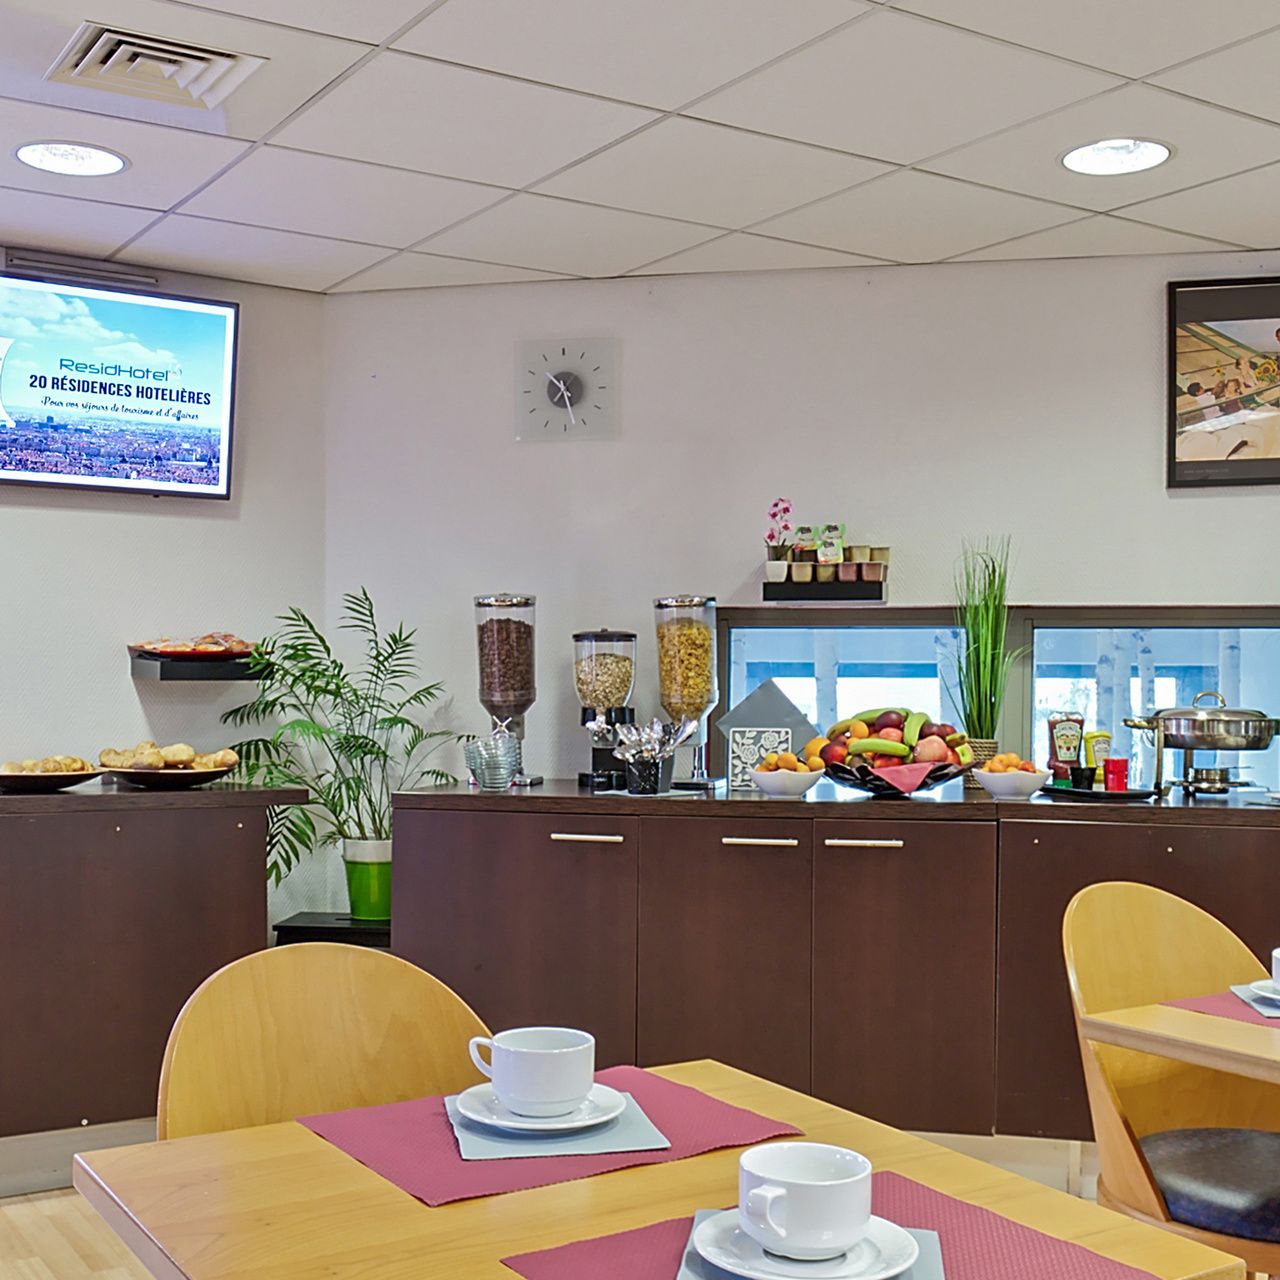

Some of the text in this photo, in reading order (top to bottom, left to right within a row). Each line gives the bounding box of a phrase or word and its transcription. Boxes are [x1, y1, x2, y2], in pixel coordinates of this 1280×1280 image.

[60, 358, 168, 381] ResidHotel
[29, 374, 211, 405] 20 RÉSIDENCES HOTELIÈRES
[81, 402, 108, 413] séjours
[111, 403, 119, 412] de
